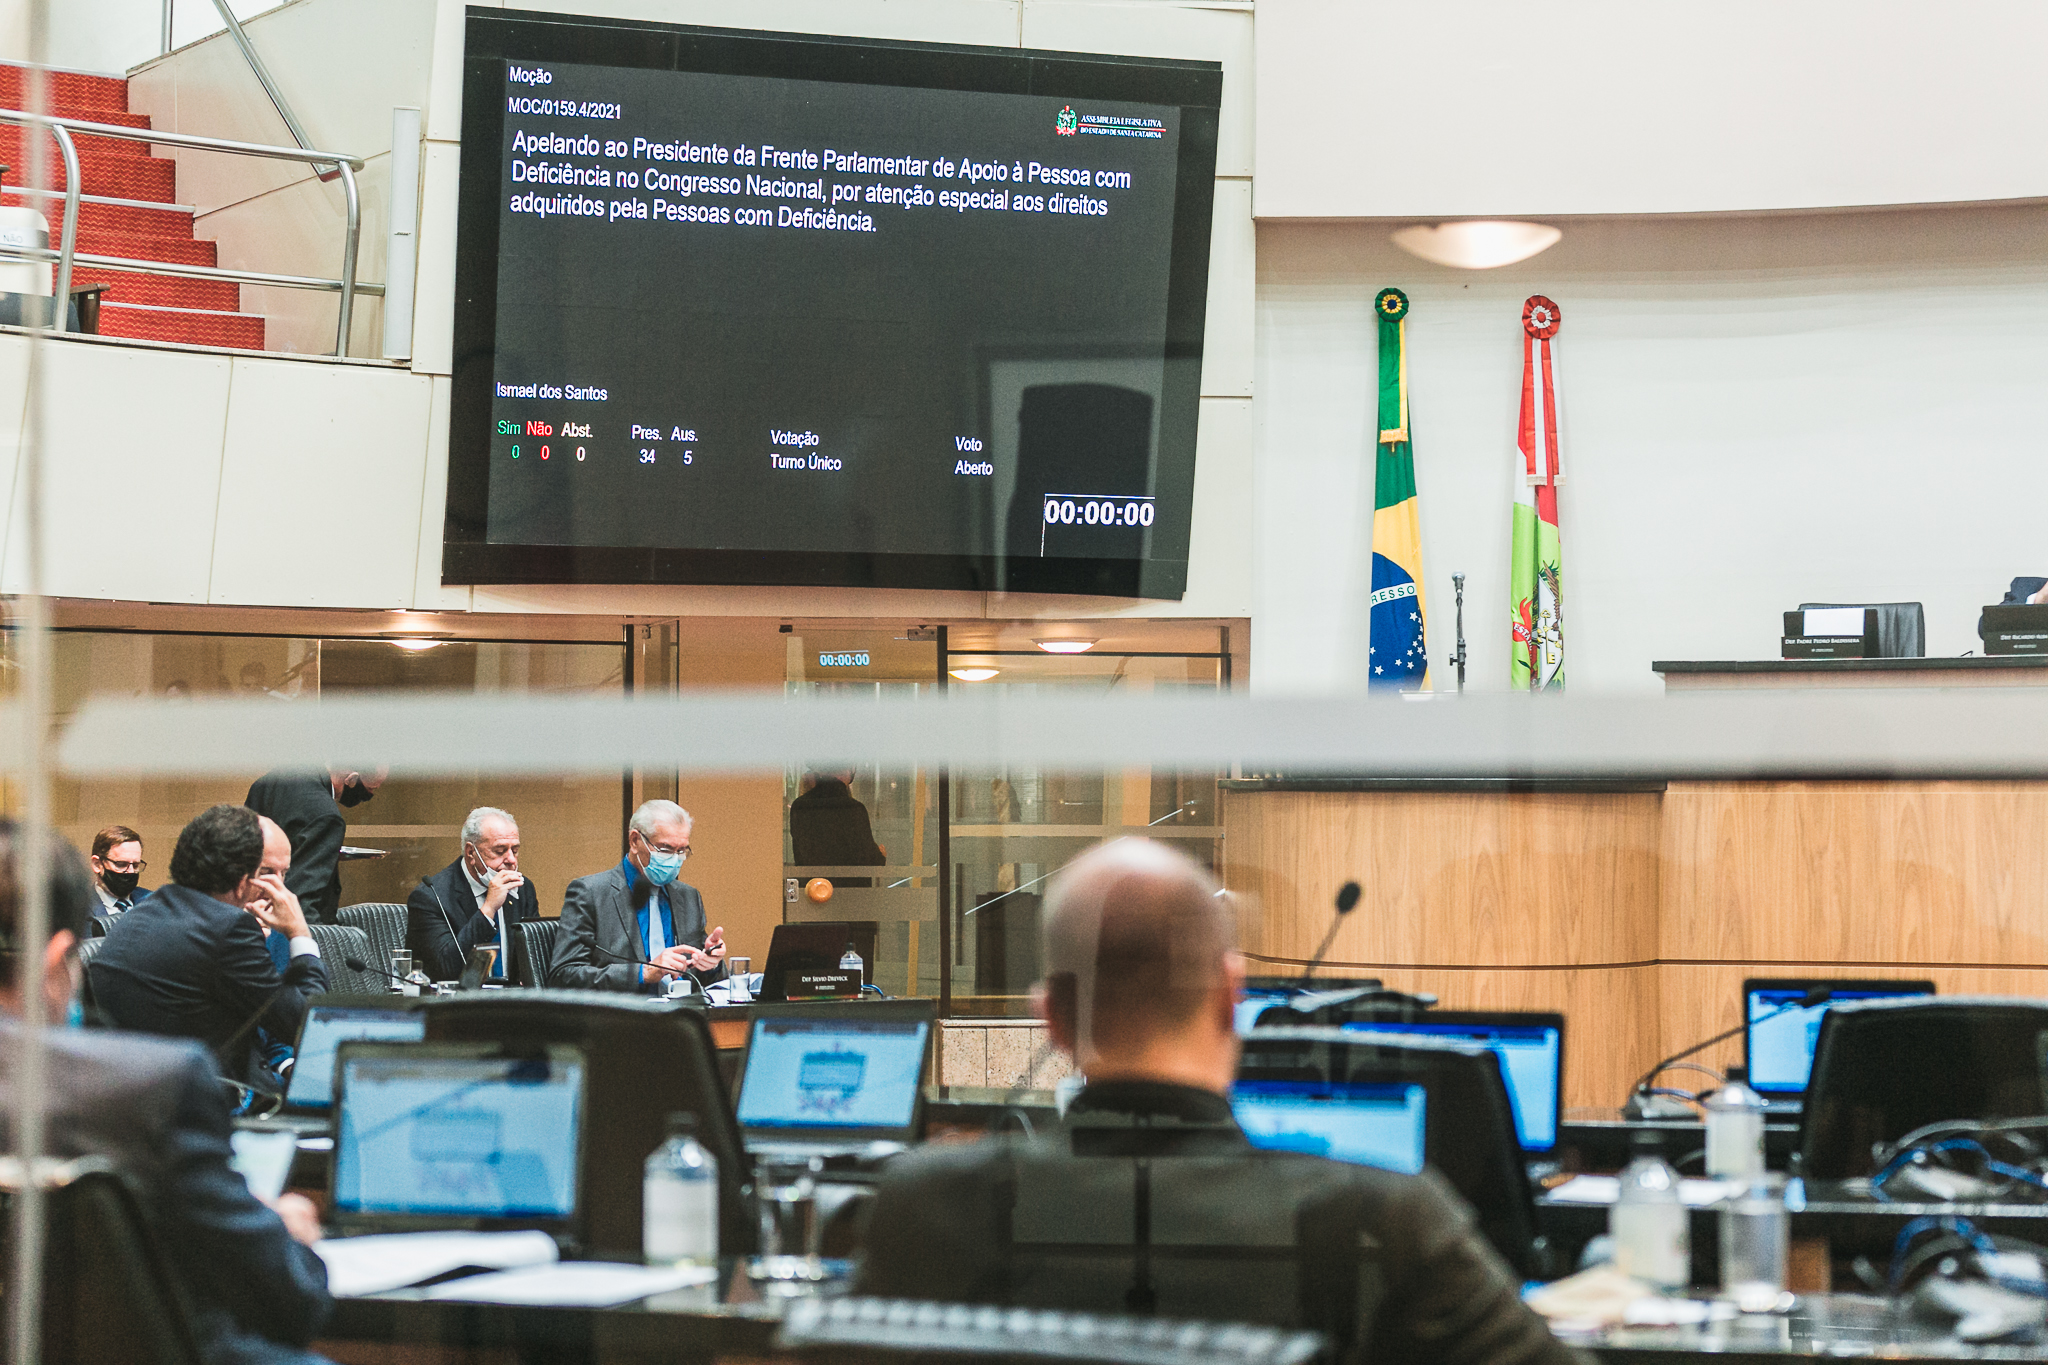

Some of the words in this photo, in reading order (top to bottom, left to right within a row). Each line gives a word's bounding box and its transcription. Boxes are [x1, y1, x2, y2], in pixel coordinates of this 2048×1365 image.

[509, 66, 552, 86] Moção
[508, 97, 622, 120] MOC/0159.4/2021
[512, 130, 600, 157] Apelando
[605, 140, 628, 158] ao
[633, 137, 729, 164] Presidente
[732, 144, 756, 166] da
[760, 145, 818, 170] Frente
[823, 149, 929, 176] Parlamentar
[932, 156, 955, 178] de
[958, 158, 1008, 184] Apoio
[1012, 161, 1023, 182] à
[1027, 162, 1091, 186] Pessoa
[1095, 171, 1132, 189] com
[512, 160, 611, 187] Deficiência
[616, 171, 639, 188] no
[643, 167, 741, 197] Congresso
[746, 174, 826, 203] Nacional,
[832, 186, 862, 206] por
[865, 183, 934, 210] atenção
[938, 189, 1009, 212] especial
[1012, 195, 1044, 212] aos
[1048, 192, 1108, 215] direitos
[510, 191, 605, 218] adquiridos
[609, 197, 647, 222] pela
[653, 198, 730, 224] Pessoas
[734, 208, 773, 226] com
[777, 206, 876, 232] Deficiência.
[496, 382, 537, 398] Ismael
[539, 384, 562, 399] dos
[565, 384, 608, 401] Santos
[498, 420, 520, 434] Sim
[526, 421, 553, 437] Não
[561, 422, 593, 438] Abst.
[631, 425, 662, 440] Pres.
[670, 426, 698, 441] Aus.
[771, 430, 819, 448] Votação
[955, 436, 982, 451] Voto
[512, 445, 520, 458] 0
[540, 445, 550, 460] 0
[576, 447, 585, 461] 0
[640, 449, 655, 463] 34
[684, 450, 692, 465] 5
[770, 454, 805, 469] Turno
[808, 452, 842, 470] Único
[954, 460, 993, 475] Aberto
[1045, 499, 1154, 526] 00:00:00
